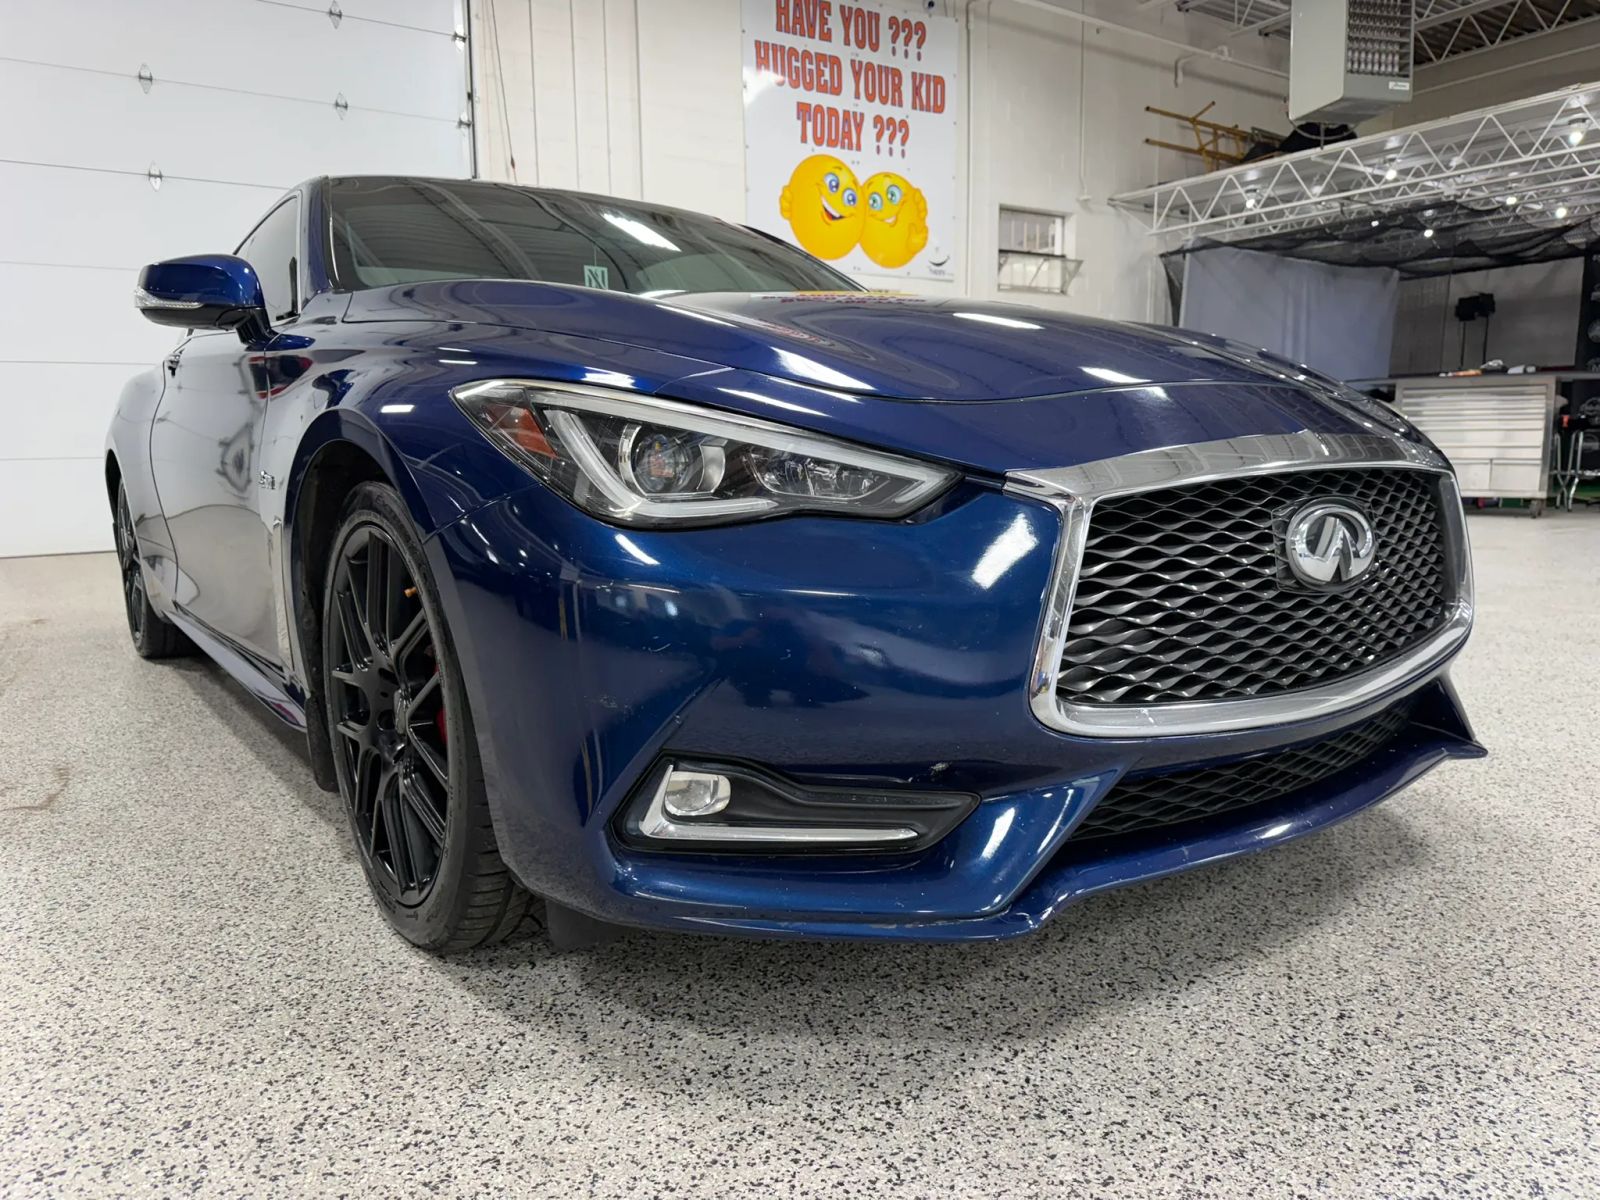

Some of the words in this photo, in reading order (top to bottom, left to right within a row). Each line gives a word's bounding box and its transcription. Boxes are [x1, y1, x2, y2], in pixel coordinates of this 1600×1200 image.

[775, 0, 832, 43] HAVE
[839, 4, 881, 53] YOU
[888, 15, 927, 62] ???
[754, 39, 843, 97] HUGGED
[850, 58, 904, 108] YOUR
[911, 71, 946, 114] KID
[796, 101, 865, 152] TODAY
[873, 114, 910, 159] ???
